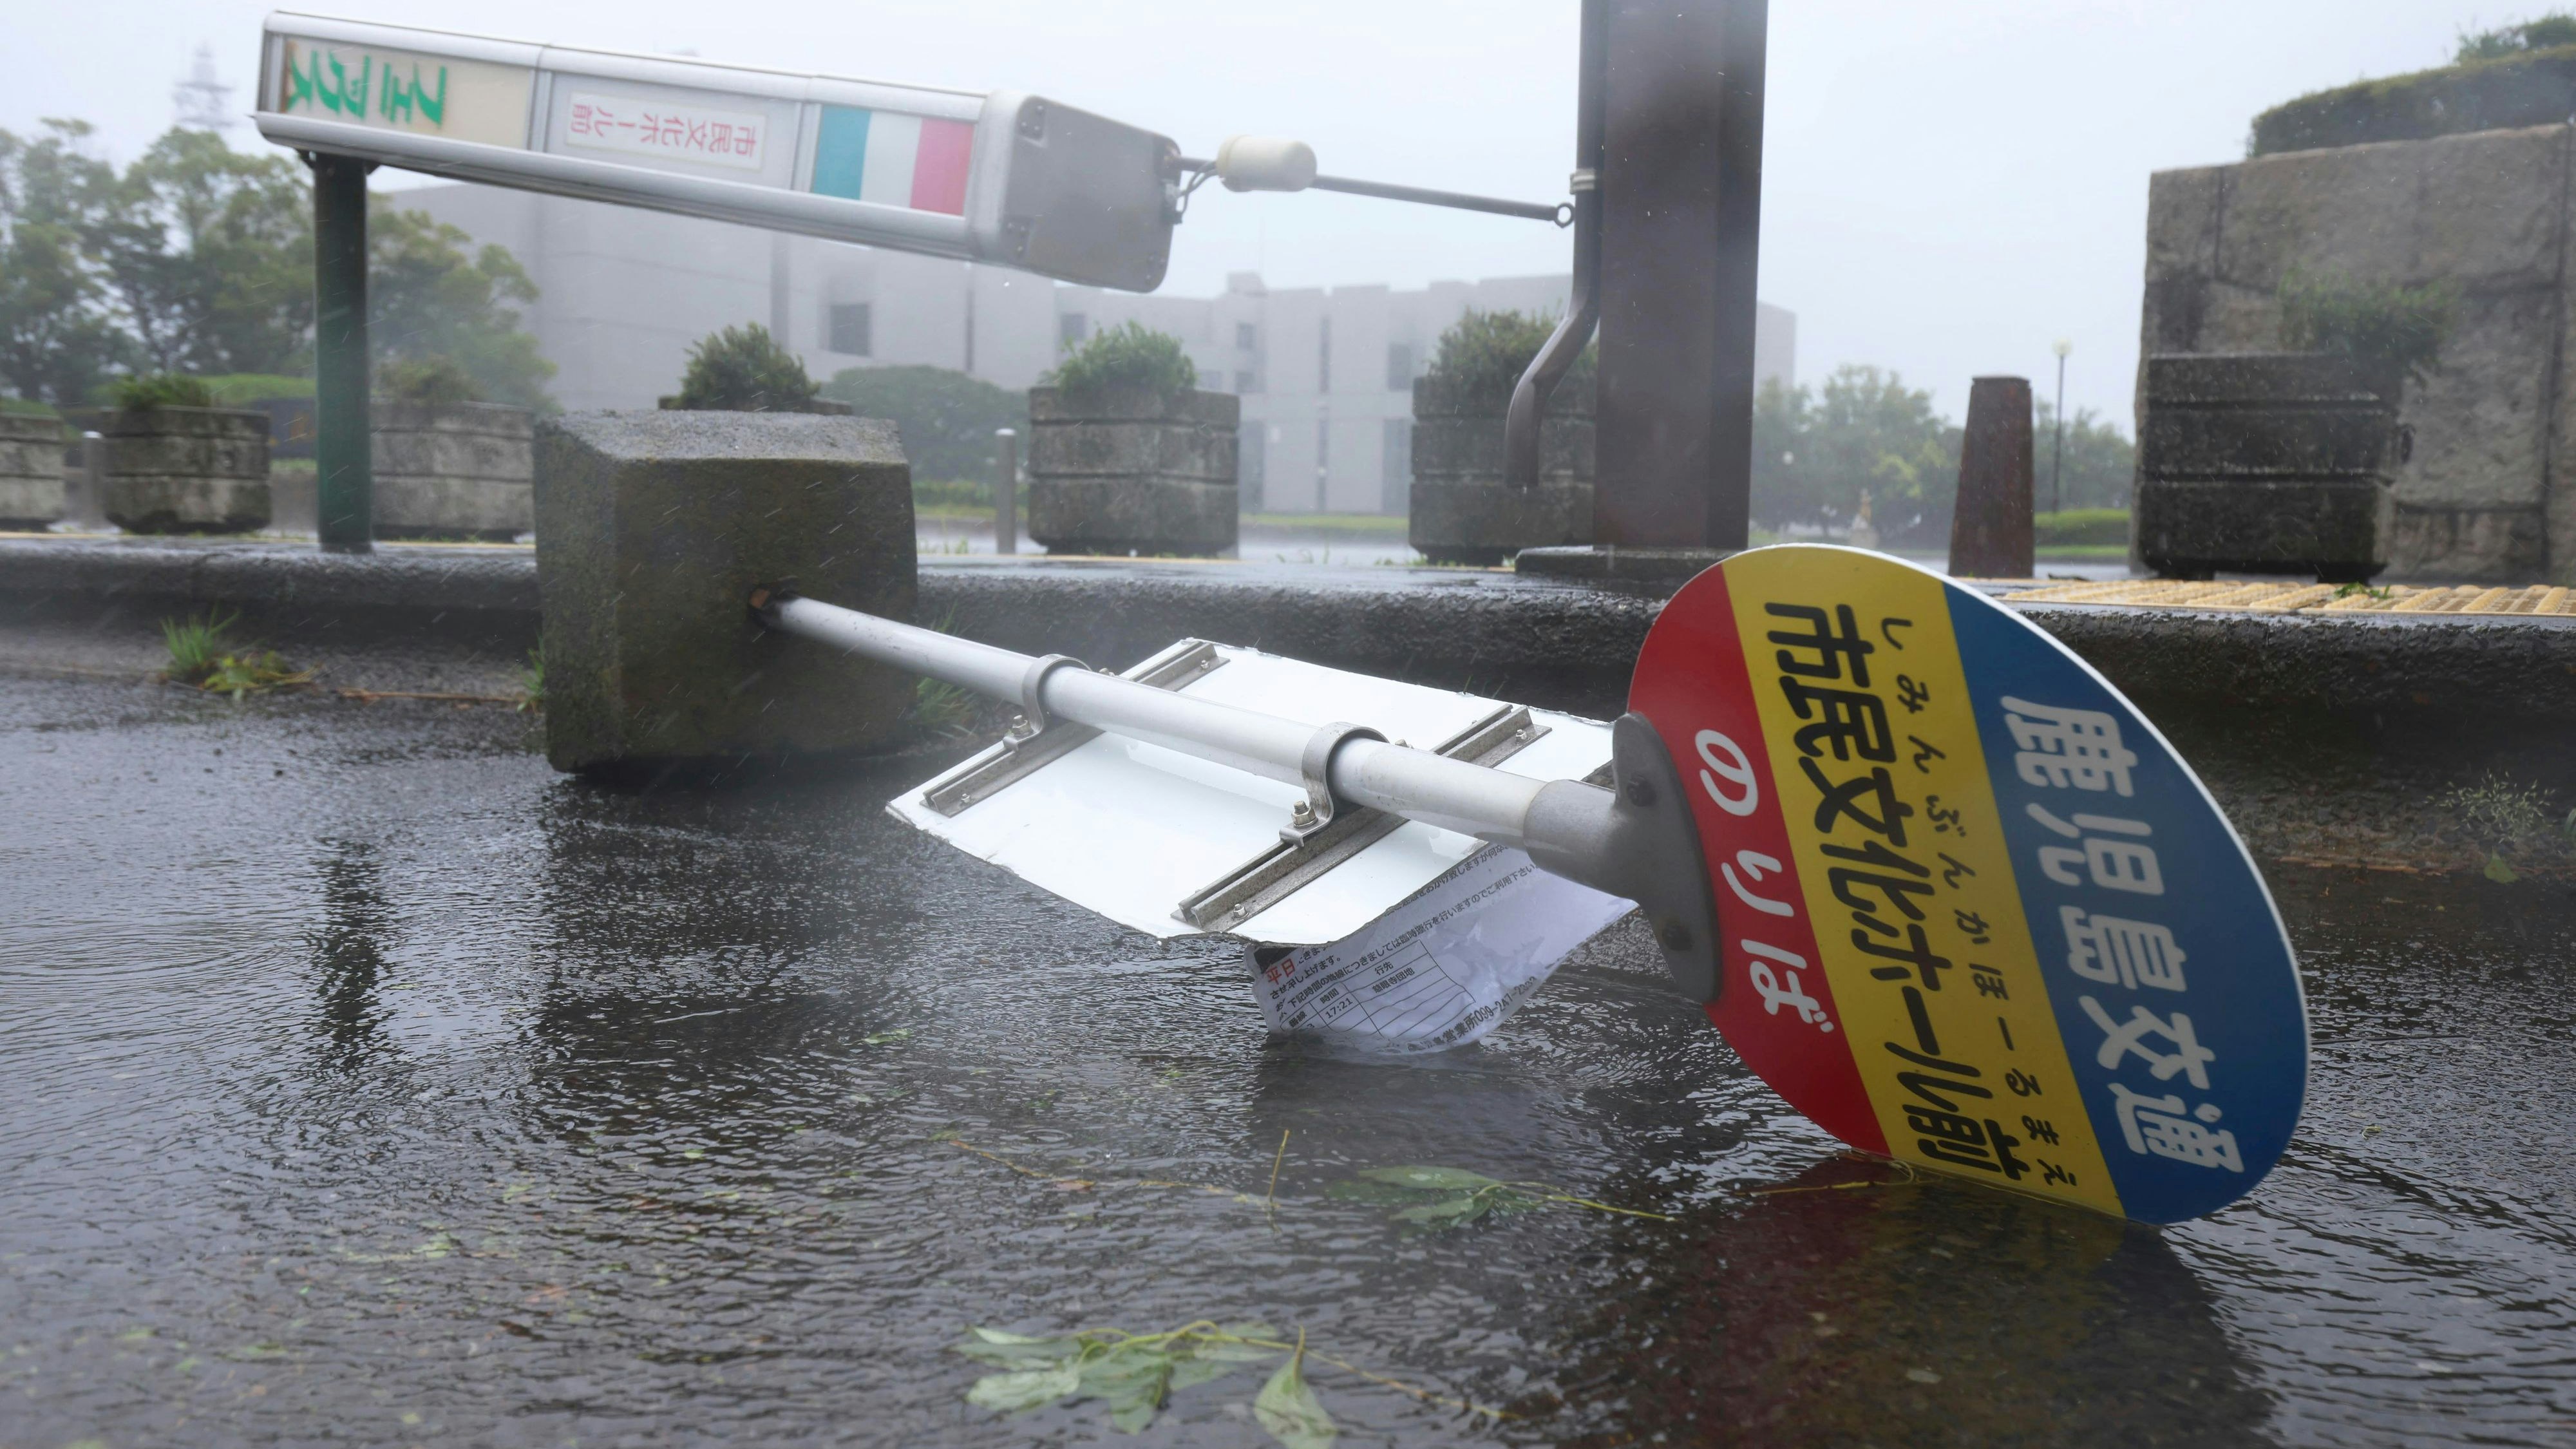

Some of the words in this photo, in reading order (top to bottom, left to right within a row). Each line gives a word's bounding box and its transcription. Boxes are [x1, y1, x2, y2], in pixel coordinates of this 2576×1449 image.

[570, 103, 756, 158] 市民文化ホール前
[1695, 729, 1834, 1033] のりば
[1765, 602, 2031, 1180] 市民文化ホール前
[1881, 617, 2077, 1186] しみんぶんかほーるまえ
[2000, 696, 2244, 1173] 鹿児島交通
[1265, 958, 1296, 985] 平日
[1320, 988, 1340, 1004] 時間
[1374, 961, 1394, 976] 行先
[1325, 998, 1353, 1019] 17:21
